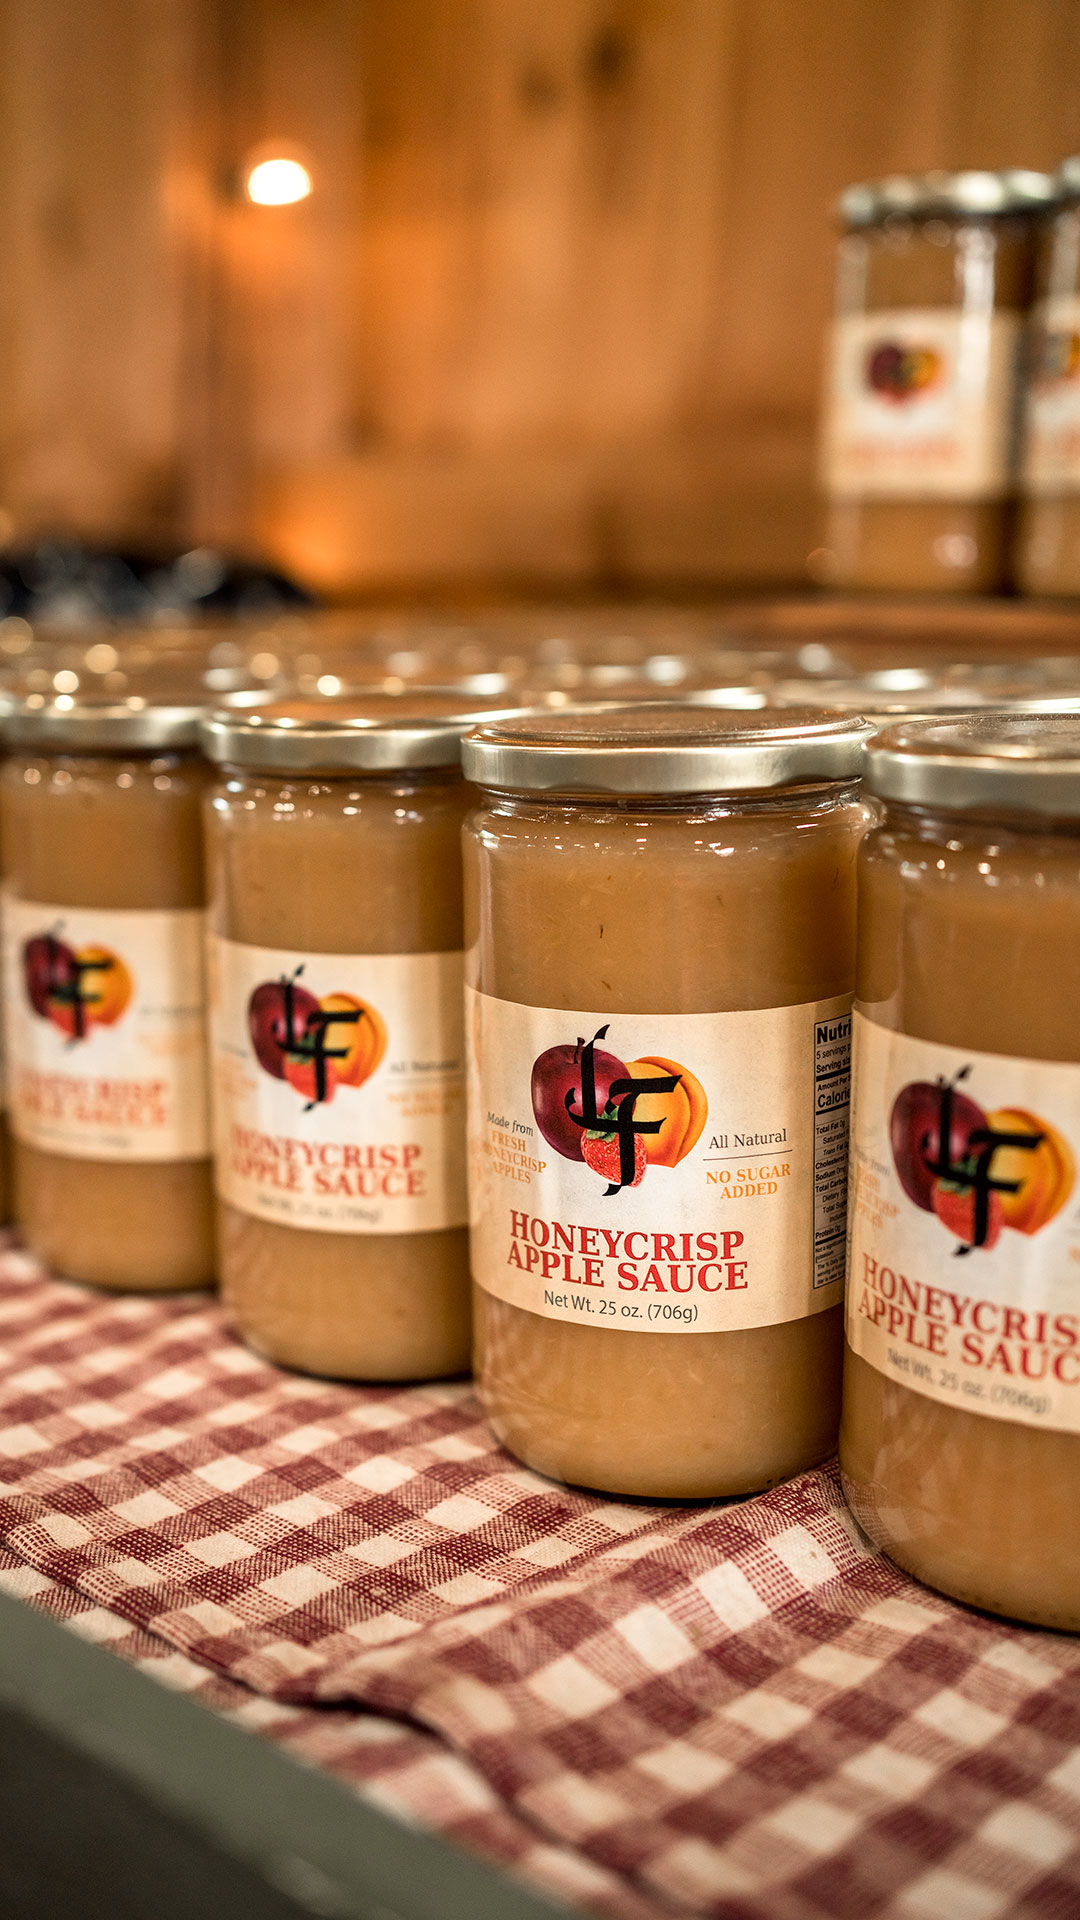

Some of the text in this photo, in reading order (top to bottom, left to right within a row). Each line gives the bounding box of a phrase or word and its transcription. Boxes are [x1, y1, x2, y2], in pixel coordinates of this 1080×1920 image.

[816, 1018, 852, 1045] Nutri
[816, 1045, 847, 1060] 5 servings
[816, 1059, 841, 1074] Serving
[817, 1080, 839, 1092] Amount
[487, 1111, 534, 1137] Made from
[816, 1124, 830, 1135] Total
[831, 1121, 839, 1131] Fat
[491, 1129, 526, 1153] FRESH
[709, 1128, 788, 1149] All Natural
[486, 1145, 547, 1174] NEYCRISP
[313, 1168, 427, 1199] SAUCE
[492, 1160, 531, 1185] APPLES
[705, 1163, 791, 1185] NO SUGAR
[815, 1169, 836, 1182] Sodium
[720, 1181, 778, 1199] ADDED
[816, 1182, 830, 1193] Total
[510, 1209, 744, 1262] HONEYCRISP
[815, 1228, 834, 1240] Protein
[507, 1240, 748, 1293] APPLE SAUCE
[544, 1289, 699, 1324] Net Wt. 25 oz. (706g)
[862, 1252, 1080, 1348] HONEYCRIS
[858, 1288, 1080, 1387] APPLE SAUC
